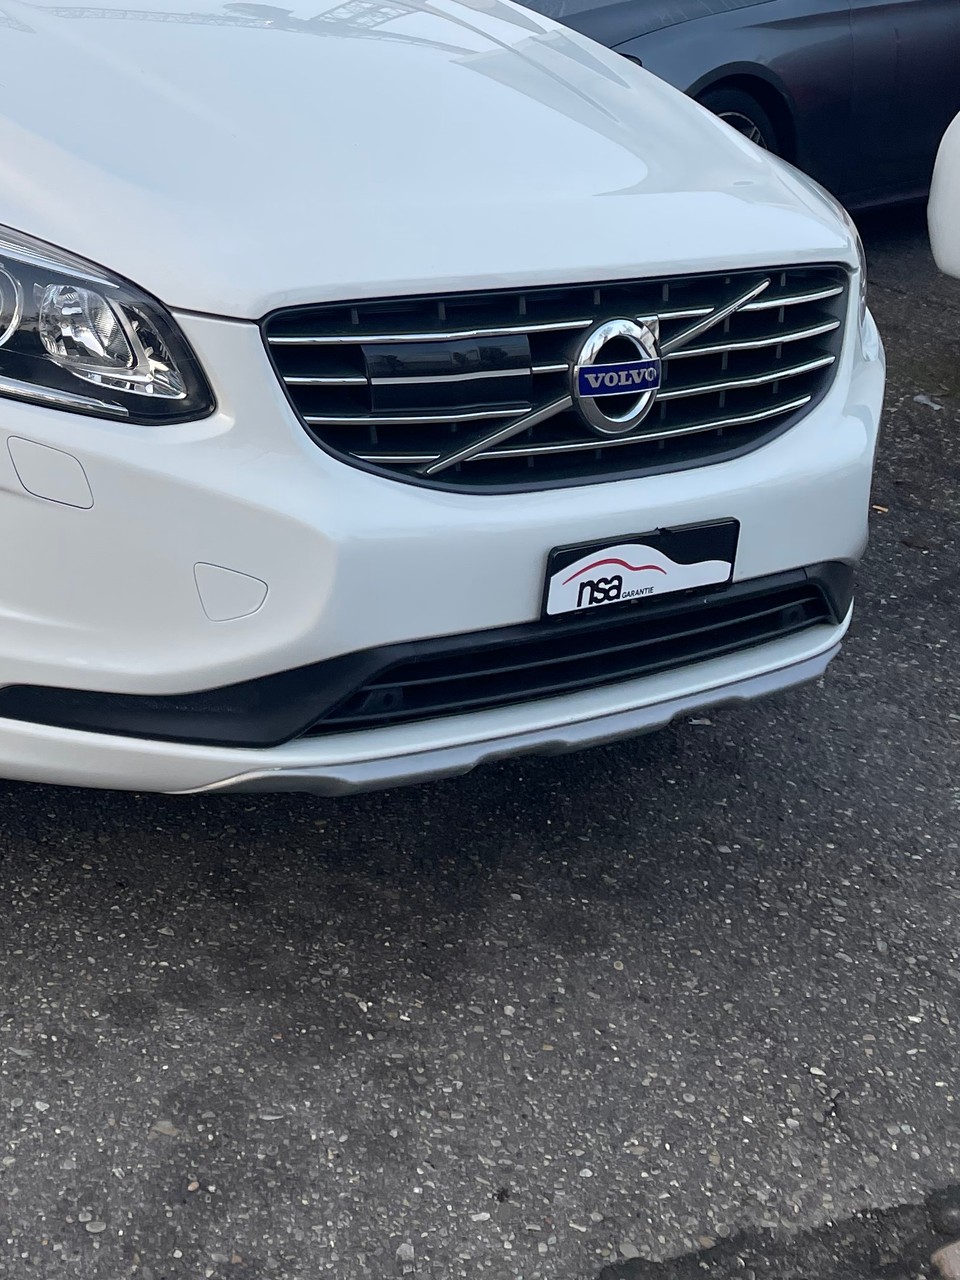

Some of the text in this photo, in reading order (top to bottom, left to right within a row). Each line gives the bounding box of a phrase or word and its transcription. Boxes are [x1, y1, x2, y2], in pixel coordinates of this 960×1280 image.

[584, 367, 657, 388] VOLVO
[577, 575, 654, 608] nsa GARANTIE
